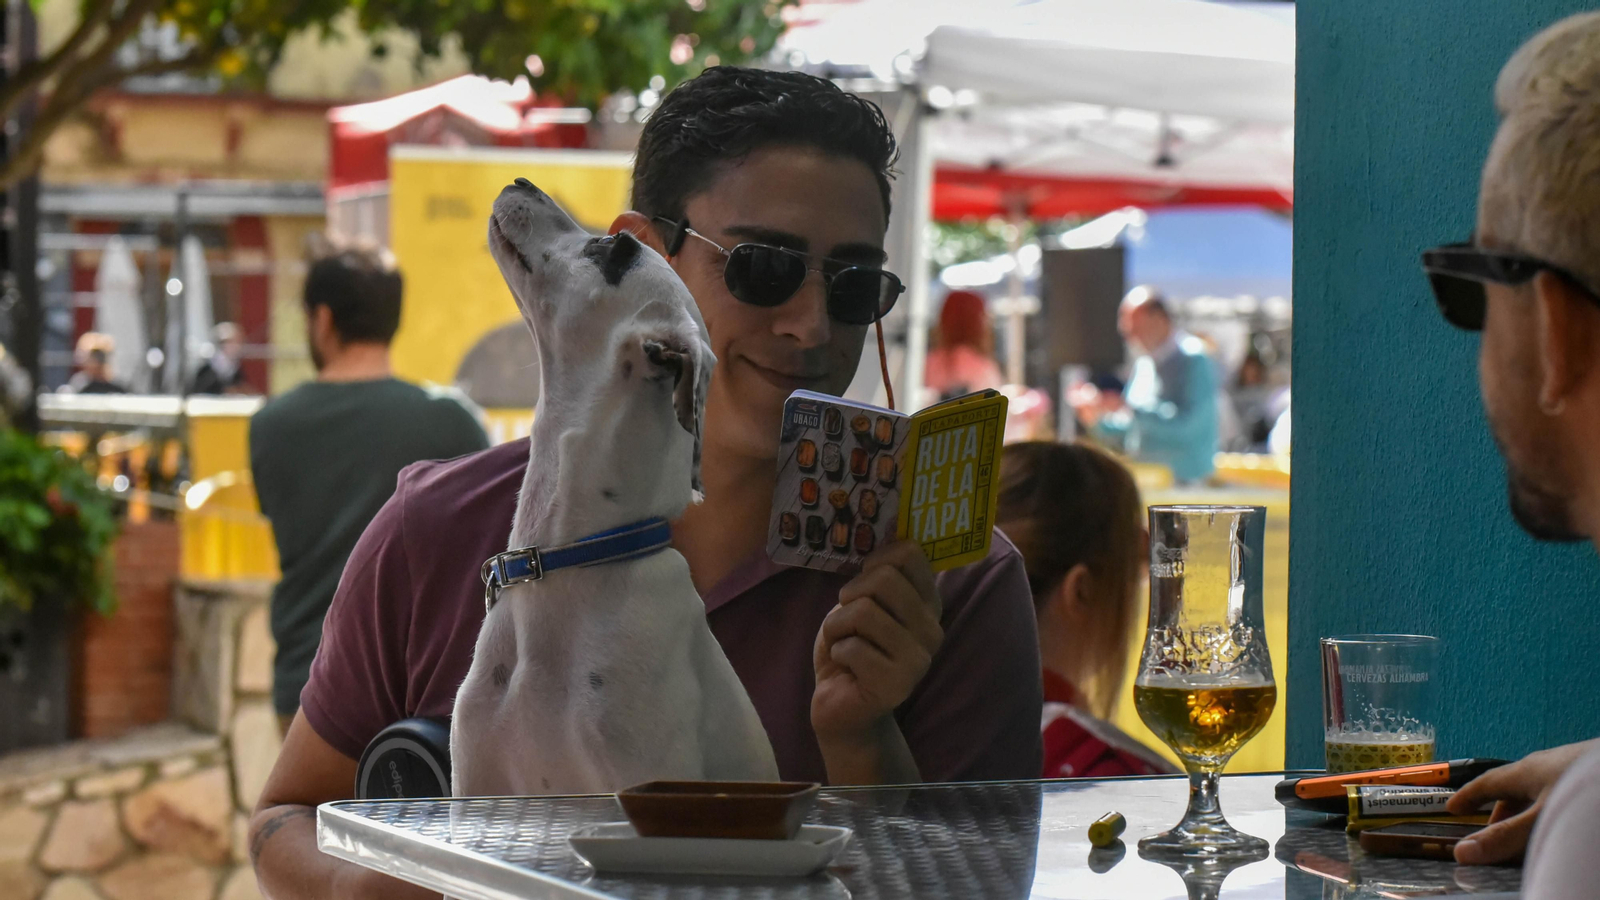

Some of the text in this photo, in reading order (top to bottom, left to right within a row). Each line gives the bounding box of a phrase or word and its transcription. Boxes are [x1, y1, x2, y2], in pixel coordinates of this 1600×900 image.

[793, 413, 818, 427] UBAGO
[917, 425, 977, 472] RUTA
[912, 469, 941, 507] DE
[947, 462, 972, 499] LA
[912, 497, 970, 543] TAPA
[1346, 672, 1429, 683] CERVEZAS ALHAMBRA
[1368, 796, 1433, 808] pharmacist
